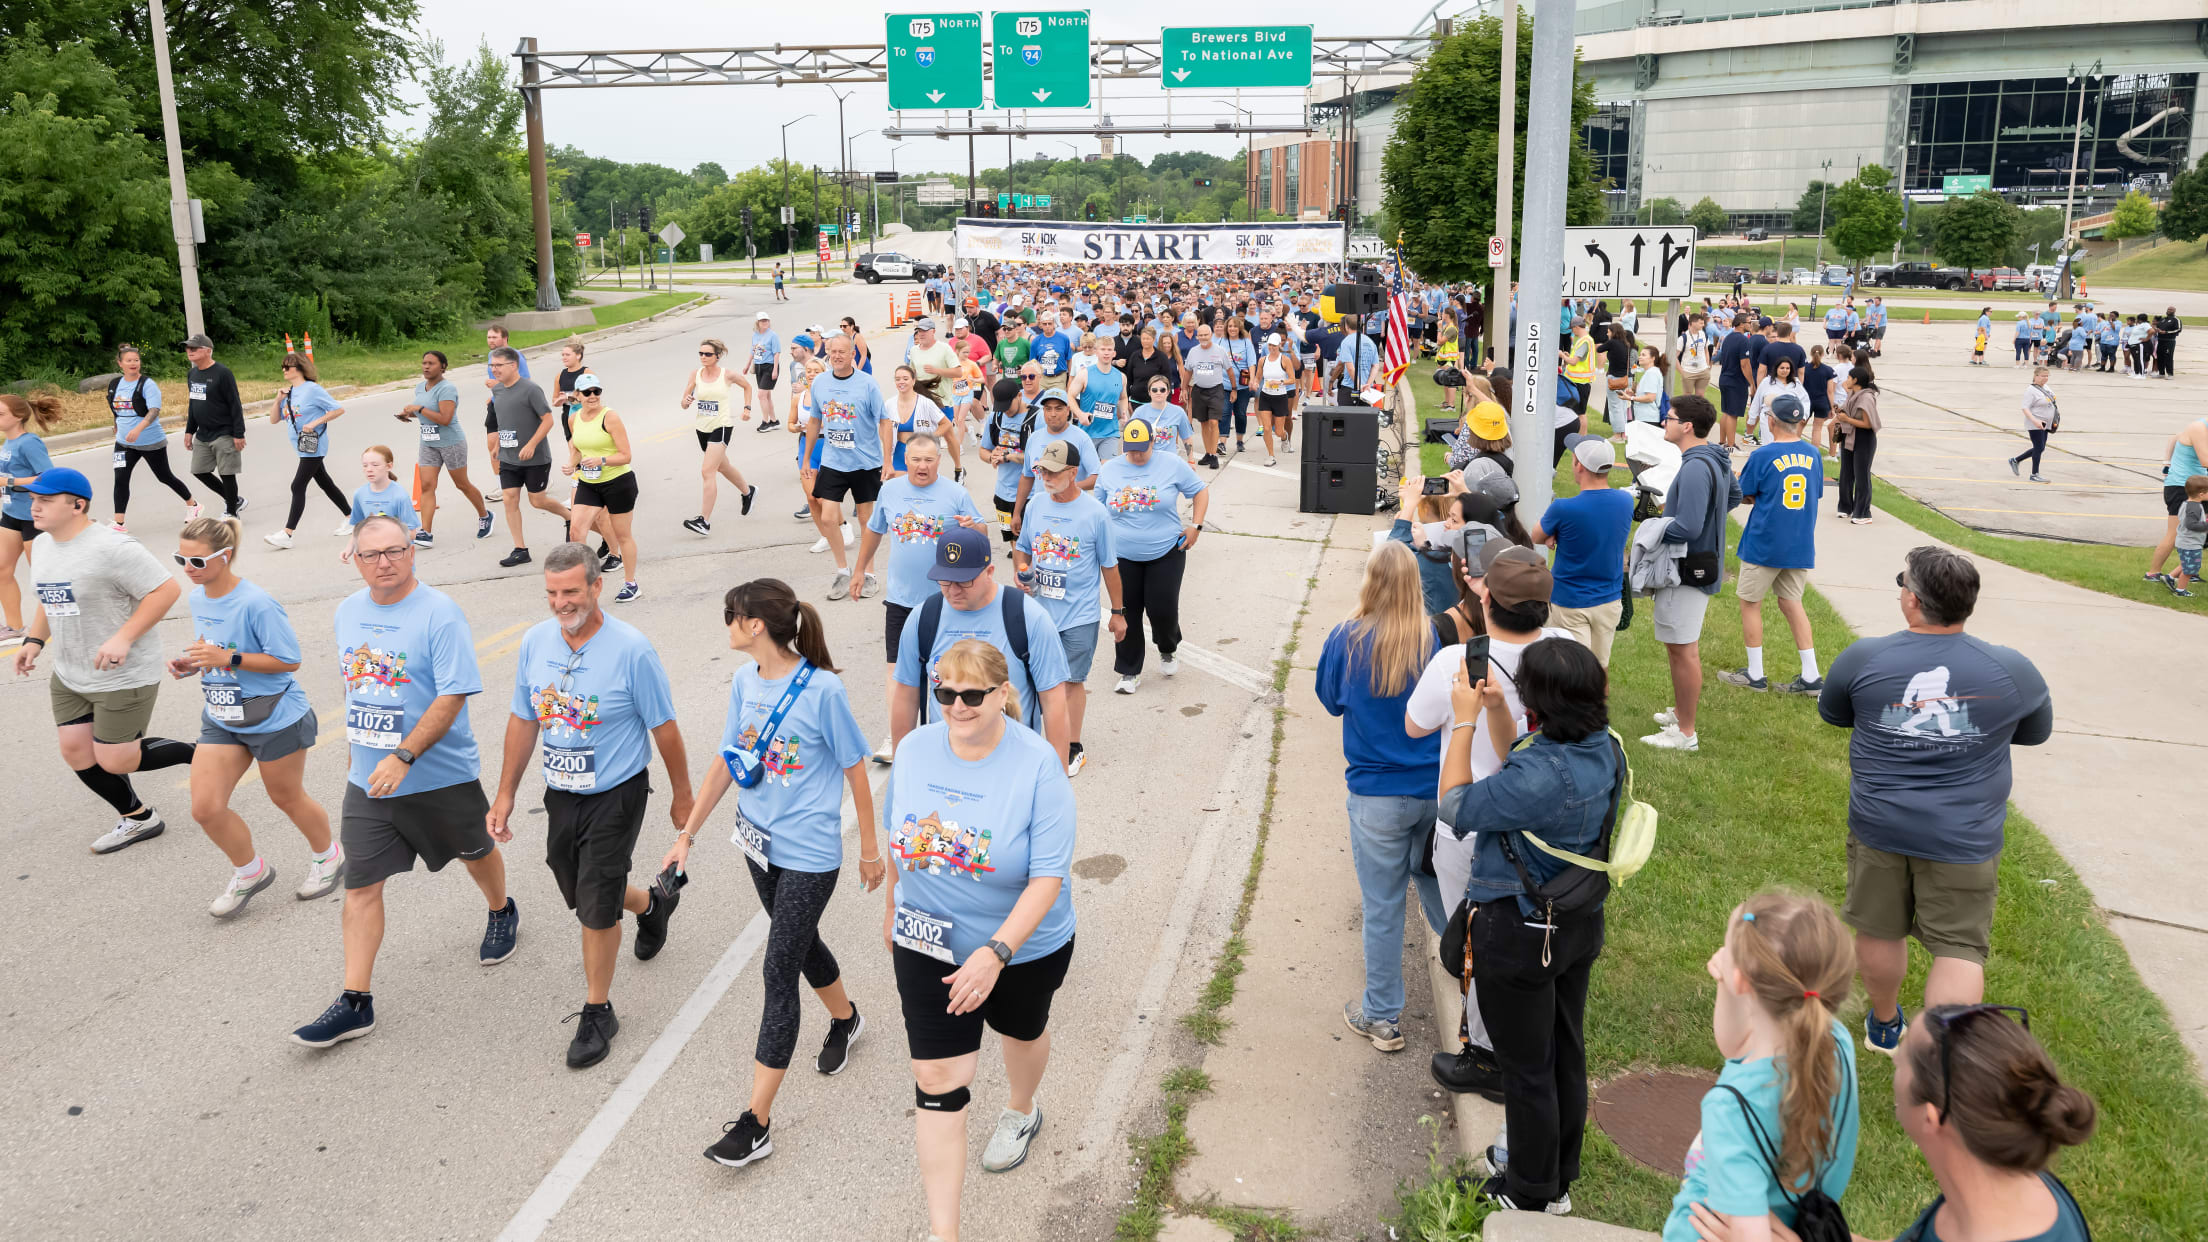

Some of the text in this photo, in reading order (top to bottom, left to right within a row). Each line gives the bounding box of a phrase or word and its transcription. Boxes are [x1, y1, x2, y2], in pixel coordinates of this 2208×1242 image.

[912, 18, 979, 34] 175 NORTH
[1018, 16, 1088, 33] 175 NORTH
[1192, 31, 1286, 43] Brewers Blvd
[918, 53, 932, 63] 94
[1025, 51, 1039, 61] 94
[1180, 48, 1294, 61] To National Ave
[1084, 232, 1210, 260] START
[1579, 282, 1611, 292] ONLY
[832, 432, 851, 441] 2574
[1772, 453, 1814, 472] BRAUN
[1782, 474, 1807, 510] 8
[1039, 573, 1061, 587] 1013
[43, 590, 70, 602] 1552
[356, 712, 394, 730] 1073
[550, 754, 586, 772] 2200
[904, 916, 944, 945] 3002
